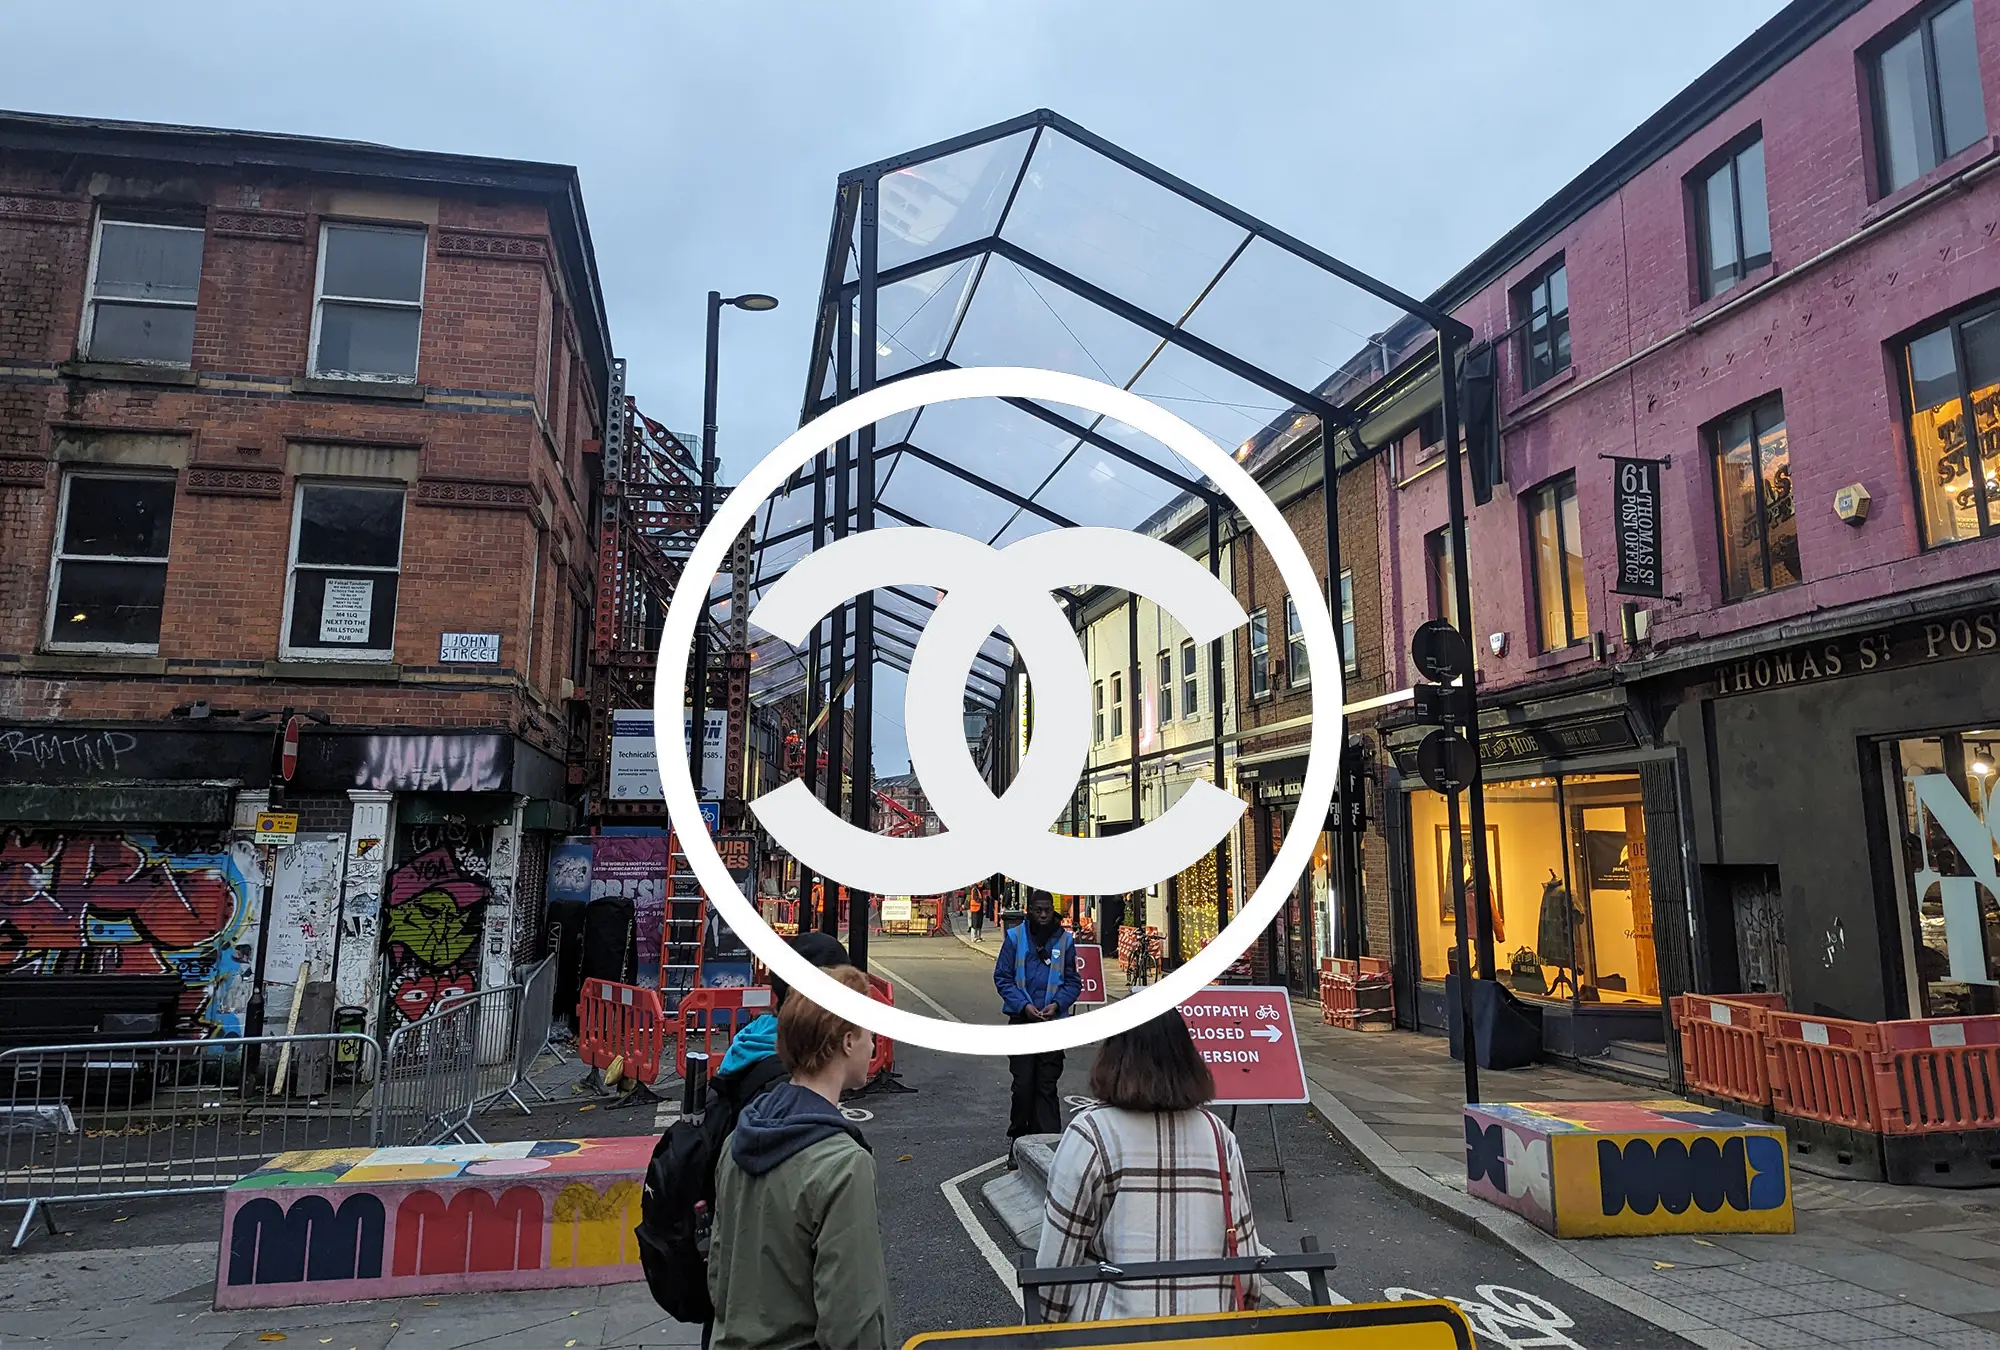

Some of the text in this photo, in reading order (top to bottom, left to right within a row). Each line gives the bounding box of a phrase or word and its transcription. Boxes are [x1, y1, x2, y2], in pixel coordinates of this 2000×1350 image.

[1621, 464, 1651, 493] 61
[1621, 494, 1639, 584] POST OFFICE
[1637, 495, 1654, 565] THOMAS
[453, 636, 487, 647] JOHN
[442, 649, 496, 660] STREET
[1715, 644, 1842, 694] THOMAS
[1509, 736, 1539, 756] HIDE
[1189, 1028, 1244, 1040] CLOSED
[1200, 1051, 1259, 1063] ERSION
